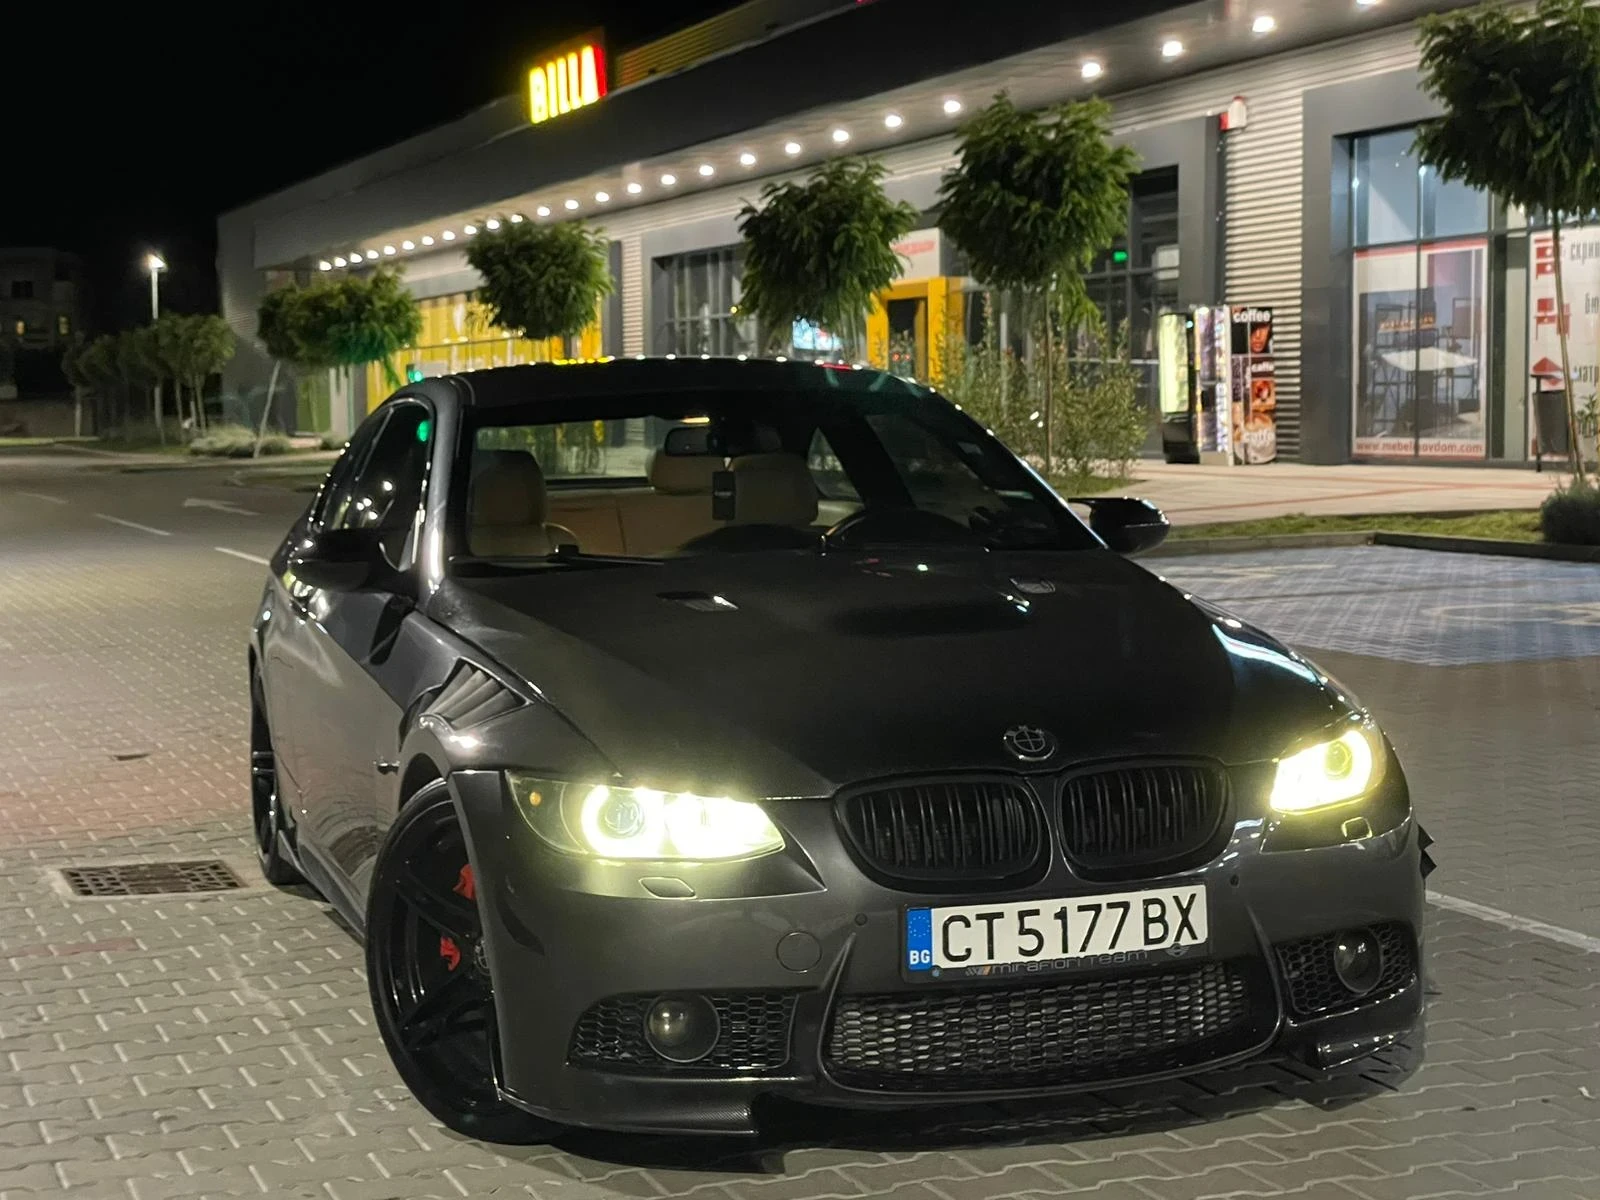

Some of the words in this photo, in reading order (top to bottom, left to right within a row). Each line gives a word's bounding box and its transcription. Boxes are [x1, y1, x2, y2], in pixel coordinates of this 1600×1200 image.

[529, 44, 607, 124] BILLA
[909, 949, 931, 964] BG
[941, 911, 1005, 962] CT
[1018, 901, 1131, 957] 5177
[1142, 893, 1198, 945] BX
